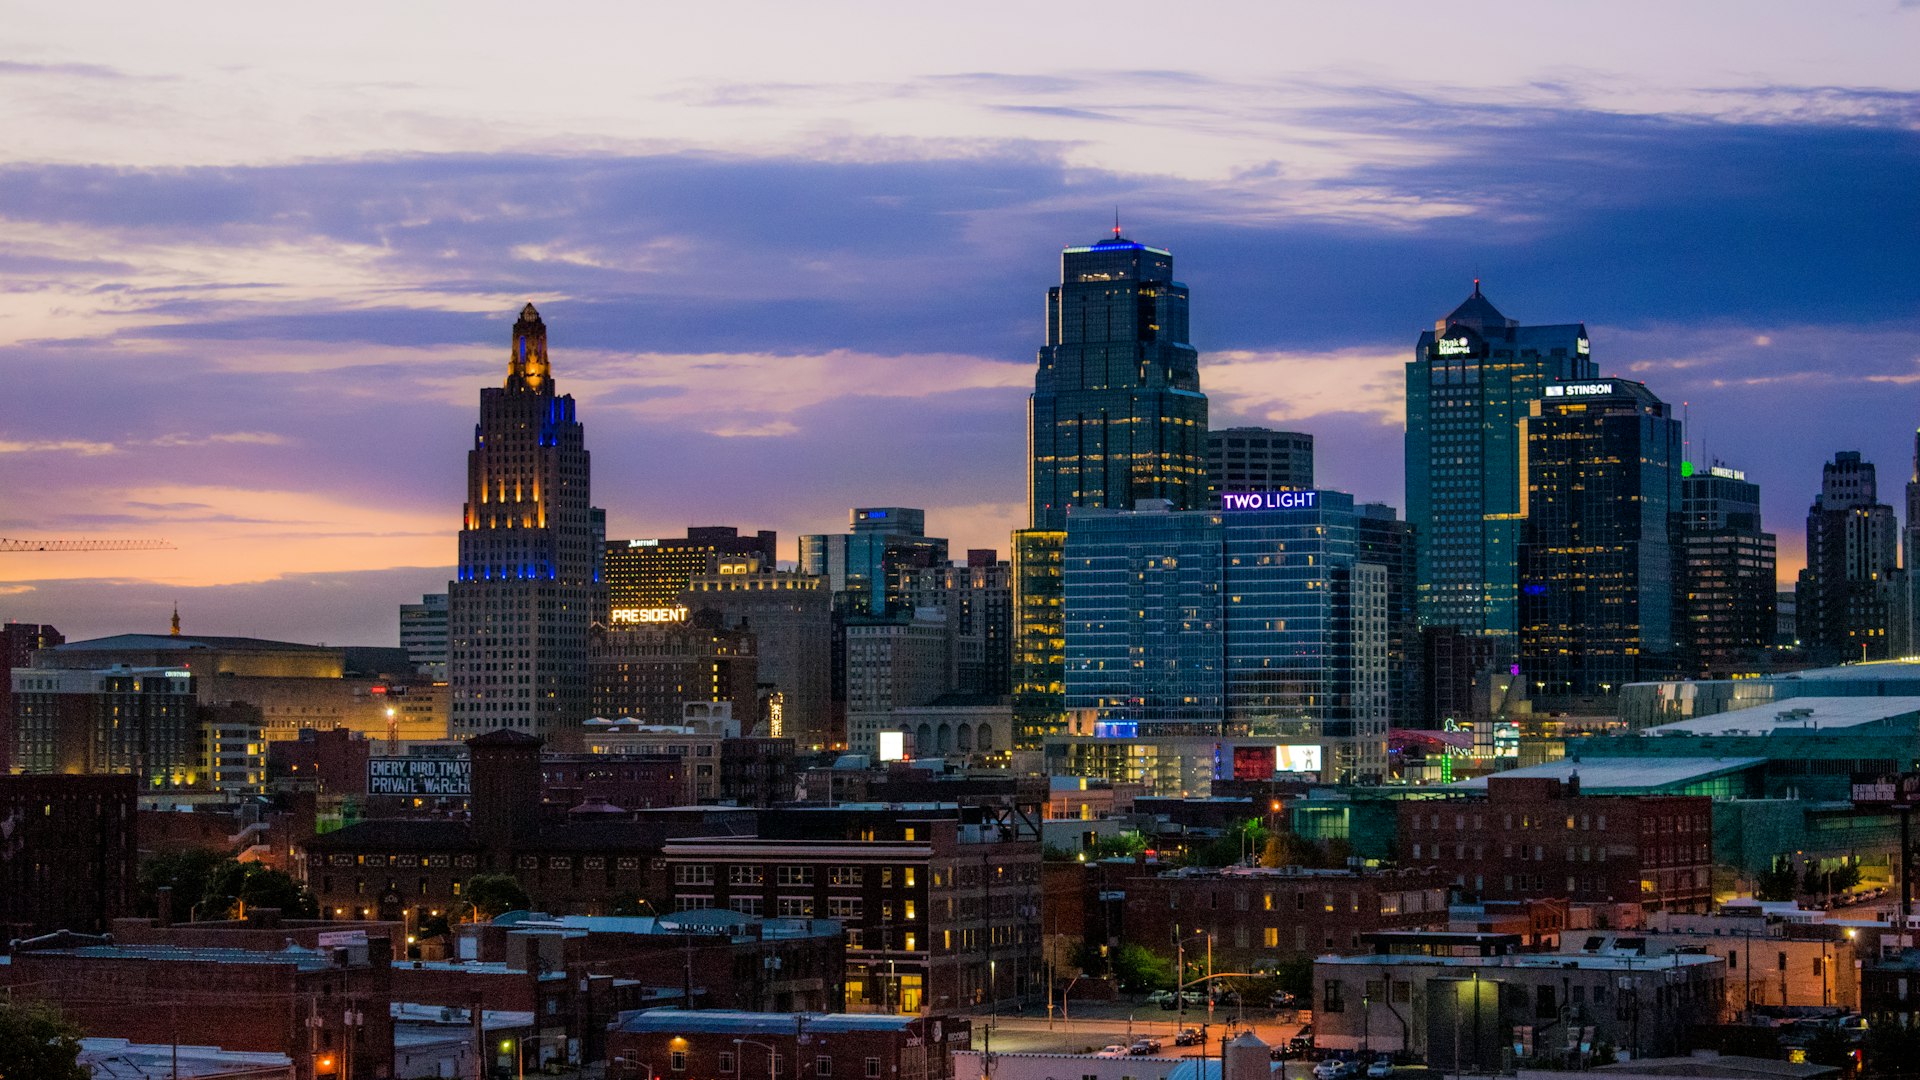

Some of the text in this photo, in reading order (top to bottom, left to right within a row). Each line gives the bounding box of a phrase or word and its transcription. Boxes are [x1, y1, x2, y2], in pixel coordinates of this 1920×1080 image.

[1565, 383, 1612, 396] STINSON
[1223, 491, 1316, 510] TWO LIGHT
[611, 607, 688, 623] PRESIDENT
[370, 760, 407, 777] EMERY
[438, 760, 472, 777] THAY
[371, 777, 472, 794] PRIVATE WAREH
